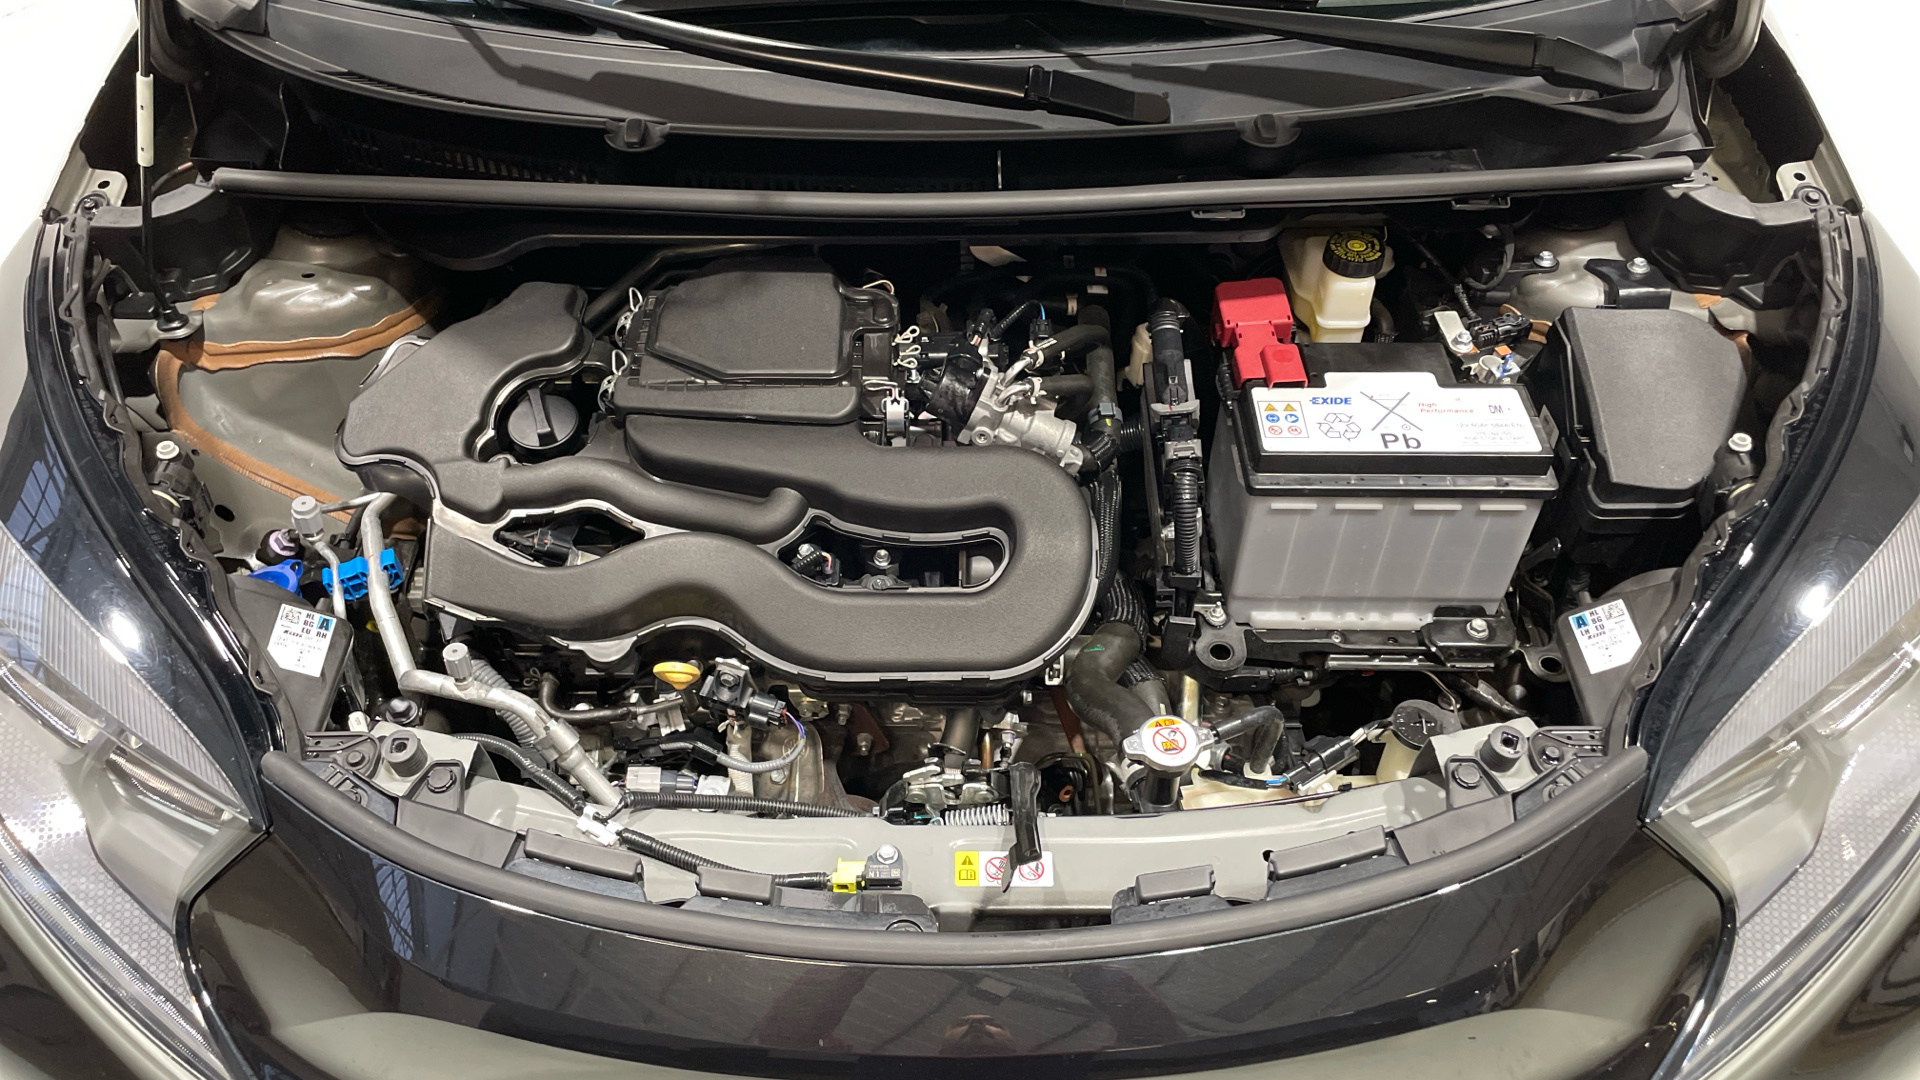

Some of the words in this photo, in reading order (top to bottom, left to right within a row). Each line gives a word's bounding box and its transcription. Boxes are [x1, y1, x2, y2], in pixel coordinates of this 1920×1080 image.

[1310, 397, 1352, 405] EXIDE
[1380, 433, 1422, 449] Pb
[319, 618, 330, 631] A
[1575, 615, 1588, 629] A
[1591, 616, 1602, 624] BG
